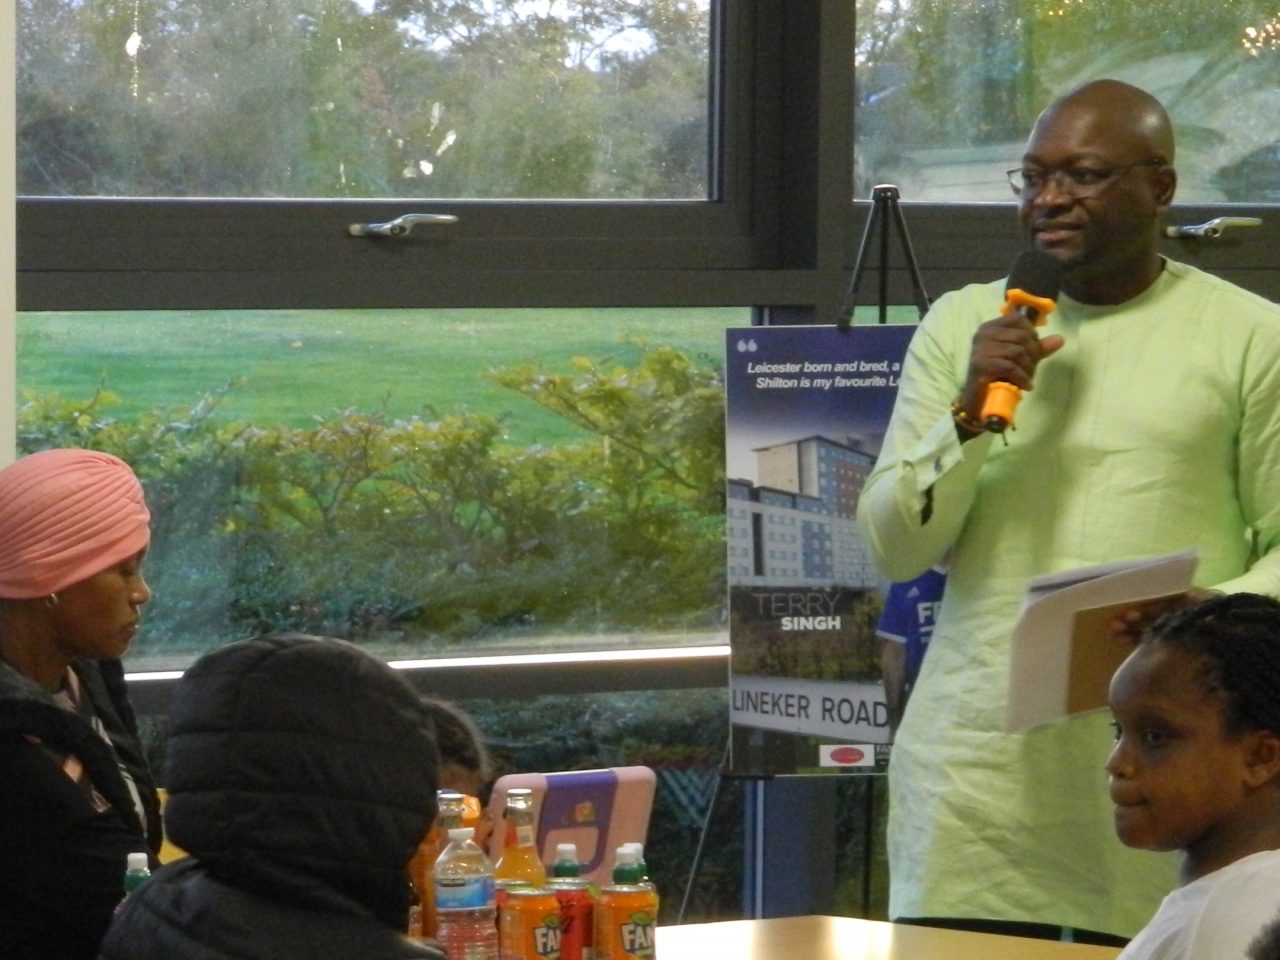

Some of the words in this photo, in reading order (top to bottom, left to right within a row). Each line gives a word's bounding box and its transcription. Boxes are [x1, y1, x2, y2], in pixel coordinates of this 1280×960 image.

[747, 361, 802, 373] Leicester
[804, 361, 832, 373] born
[834, 361, 858, 372] and
[860, 360, 889, 372] bred,
[756, 377, 798, 389] Shilton
[800, 376, 810, 388] is
[813, 379, 834, 390] my
[835, 376, 887, 387] favourite
[753, 592, 841, 616] TERRY
[781, 616, 841, 631] SINGH
[732, 688, 810, 719] LINEKER
[822, 697, 889, 728] ROAD
